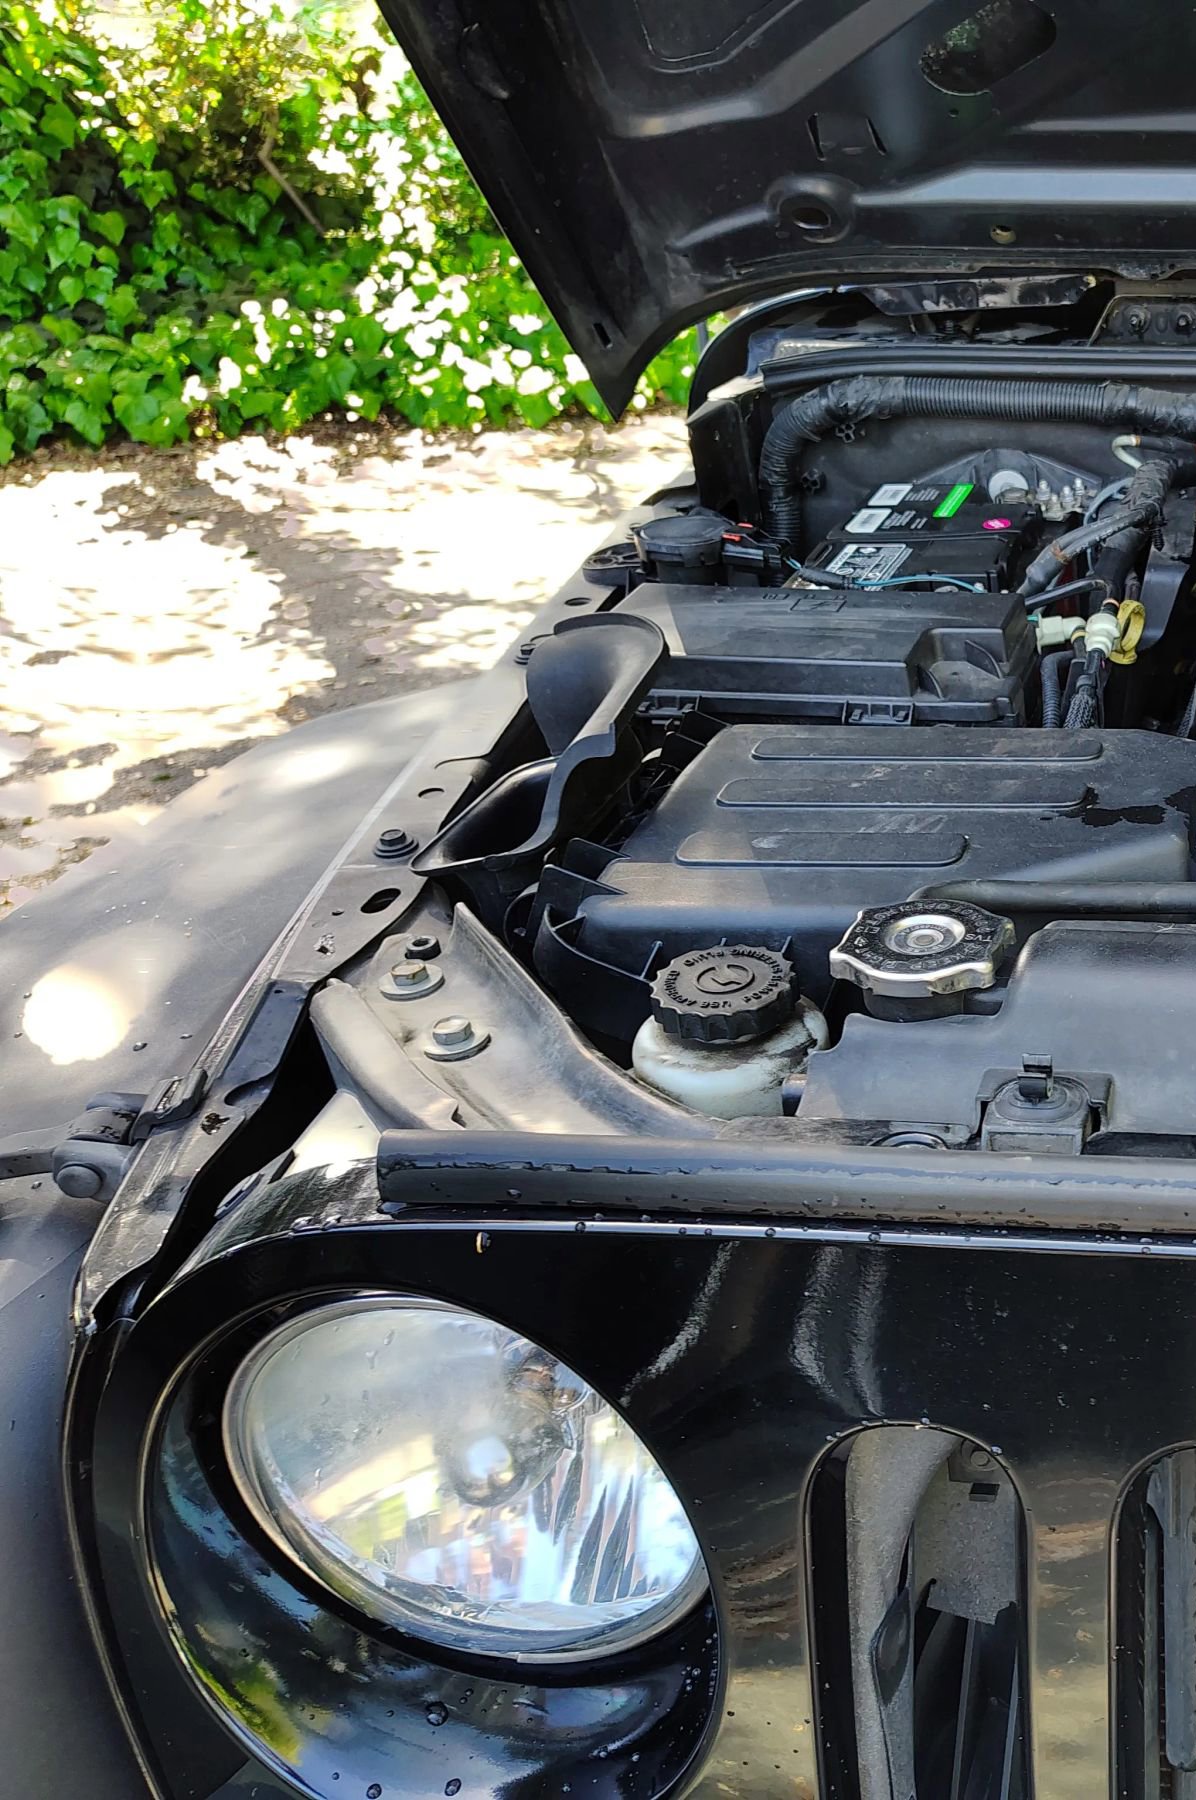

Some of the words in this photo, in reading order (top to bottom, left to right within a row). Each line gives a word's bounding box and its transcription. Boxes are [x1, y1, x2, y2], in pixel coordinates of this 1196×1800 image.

[853, 925, 880, 934] E13
[965, 933, 992, 942] TVS
[683, 949, 725, 968] FLUID
[699, 1000, 732, 1009] USE
